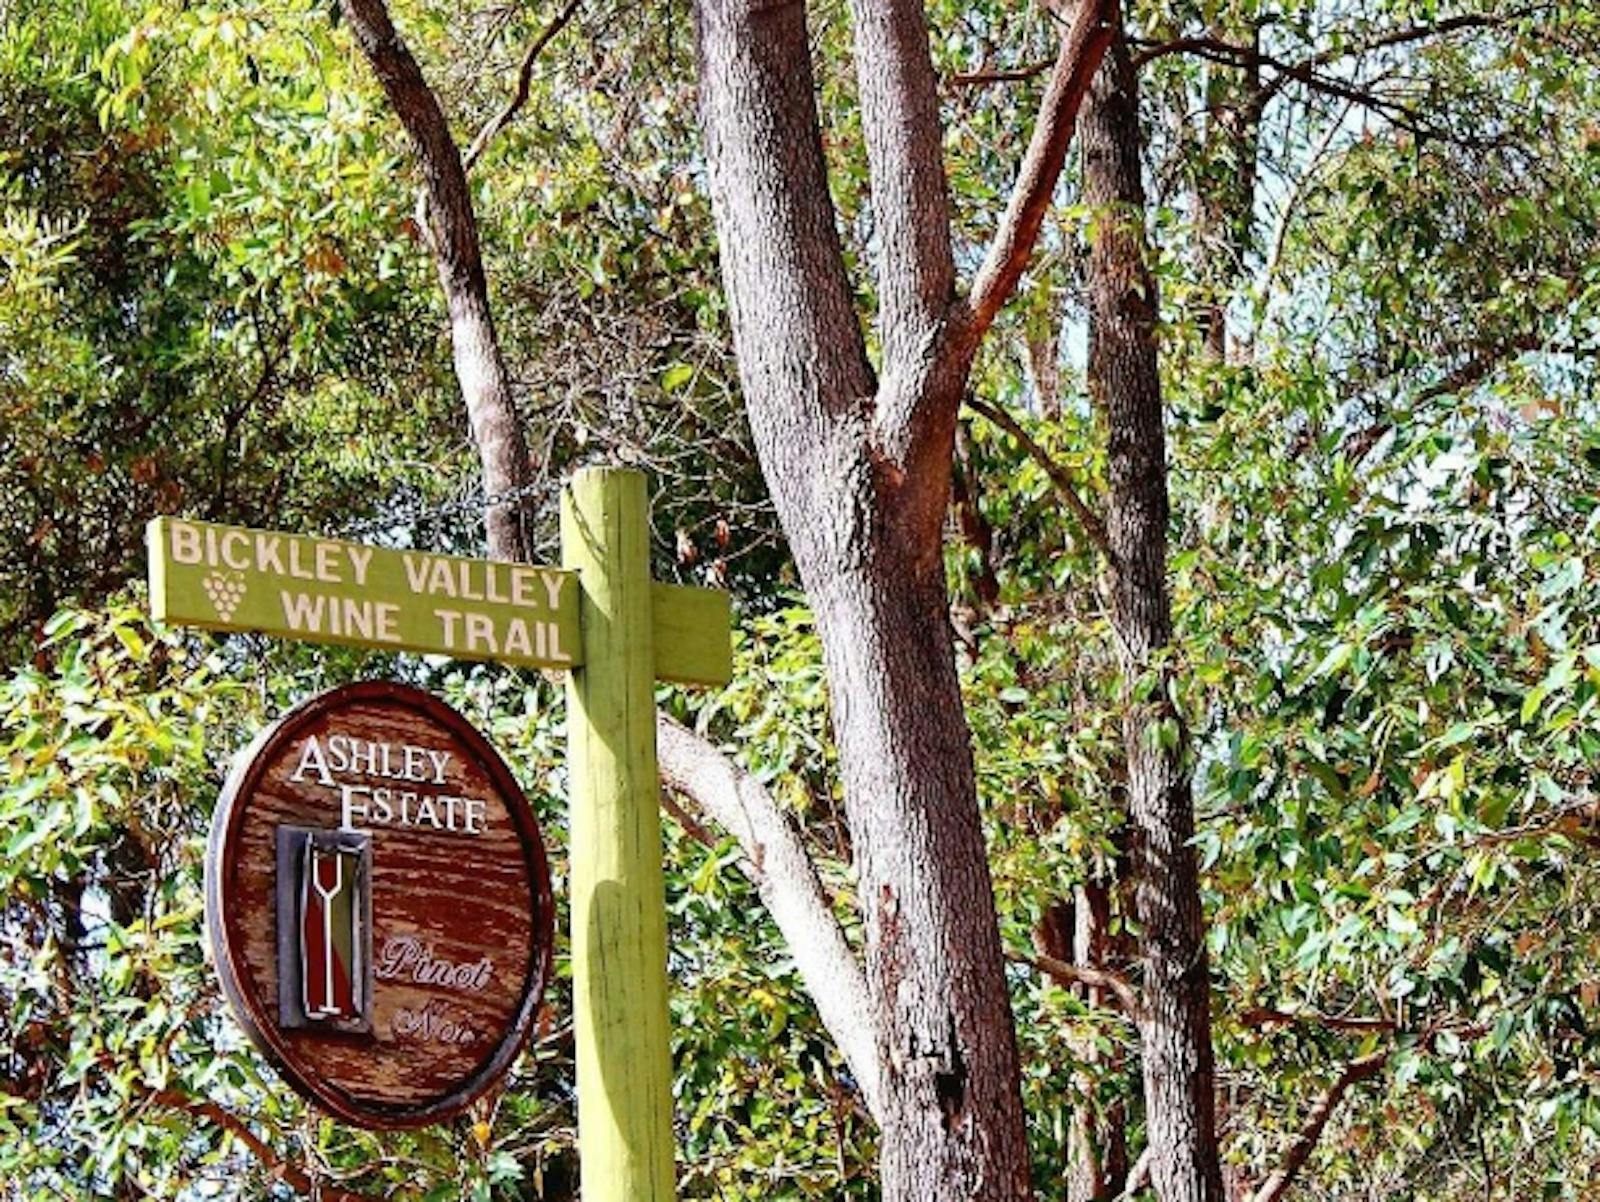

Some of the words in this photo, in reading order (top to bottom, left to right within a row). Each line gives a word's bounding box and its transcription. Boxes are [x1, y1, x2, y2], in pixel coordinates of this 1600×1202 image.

[170, 522, 374, 586] BICKLEY
[402, 554, 569, 611] VALLEY
[281, 590, 401, 641] WINE
[433, 608, 572, 662] TRAIL
[289, 733, 452, 786] ASHLEY
[337, 784, 488, 837] ESTATE
[372, 935, 494, 992] Pinot
